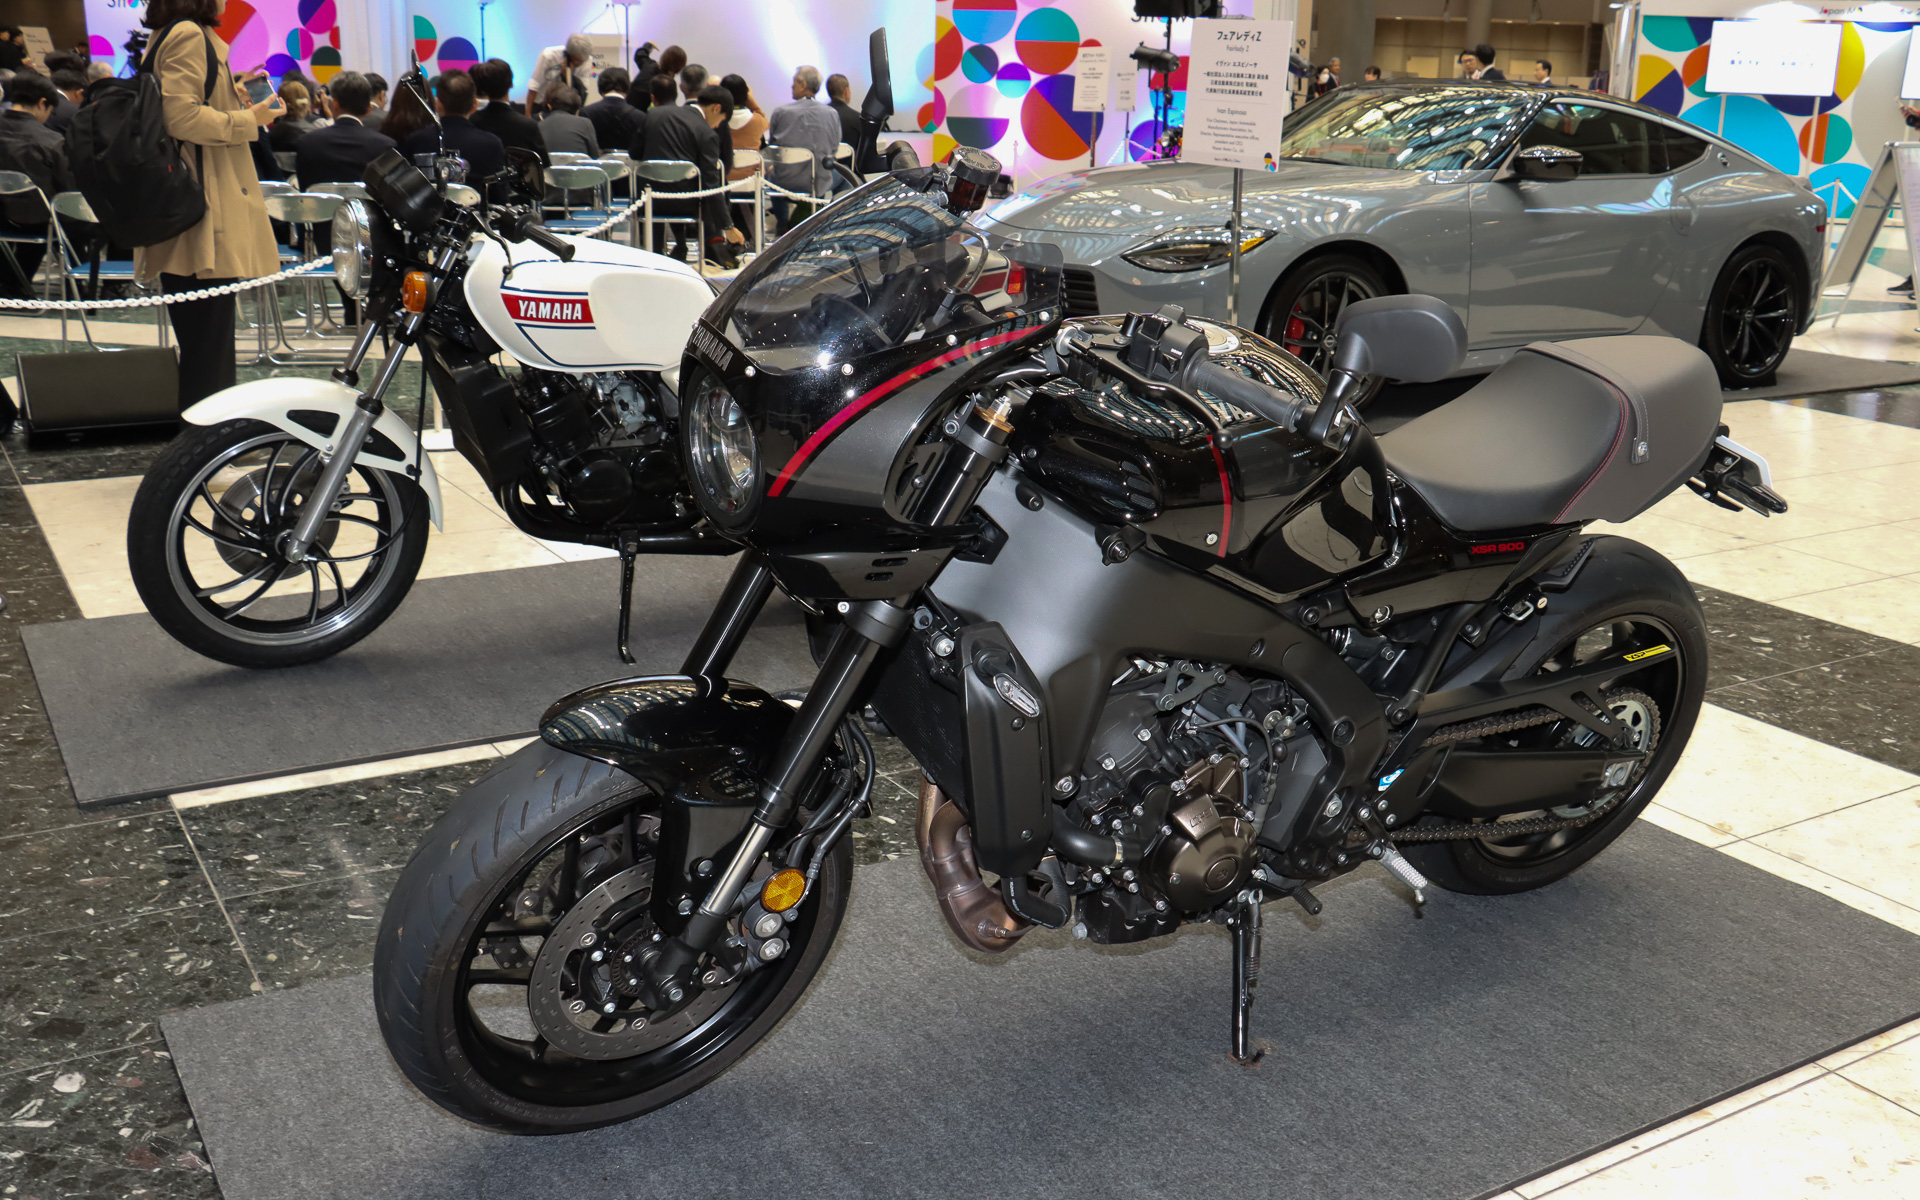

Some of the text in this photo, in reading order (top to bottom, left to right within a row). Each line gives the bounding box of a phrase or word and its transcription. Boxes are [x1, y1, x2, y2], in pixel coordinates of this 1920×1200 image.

[1217, 30, 1262, 42] フェアレディZ
[518, 299, 582, 320] YAMAHA
[692, 325, 734, 371] YAMAHA
[1472, 542, 1524, 554] XSR 900
